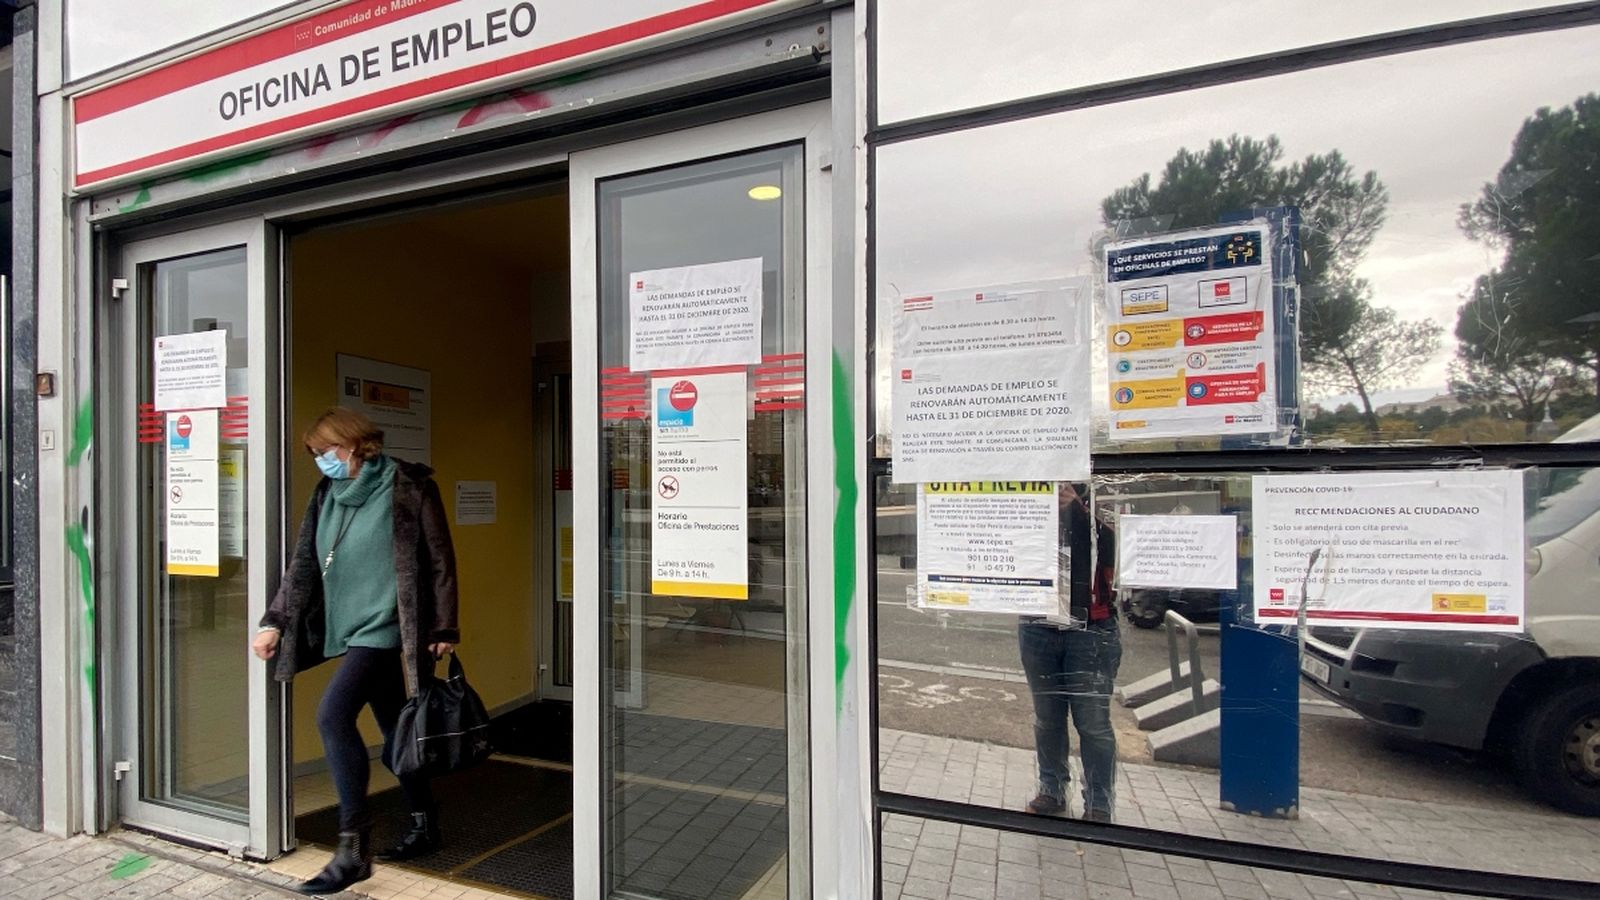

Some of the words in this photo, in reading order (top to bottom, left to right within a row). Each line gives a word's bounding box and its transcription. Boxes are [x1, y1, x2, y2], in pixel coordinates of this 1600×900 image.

[315, 10, 372, 36] Comunidad
[374, 5, 387, 17] de
[219, 62, 331, 121] OFICINA
[340, 47, 381, 87] DE
[390, 1, 537, 73] EMPLEO
[1113, 256, 1131, 265] ¿QUÉ
[1133, 251, 1171, 262] SERVICIOS
[1184, 245, 1218, 255] PRESTAN
[1125, 262, 1159, 272] OFICINAS
[1172, 256, 1206, 267] EMPLEO?
[660, 291, 695, 300] DEMANDAS
[706, 287, 732, 296] EMPLEO
[1130, 290, 1160, 303] SEPE
[687, 309, 720, 318] DICIEMBRE
[918, 387, 934, 395] LAS
[936, 384, 990, 395] DEMANDAS
[991, 383, 1001, 391] DE
[1006, 380, 1045, 390] EMPLEO
[1047, 379, 1058, 388] SE
[910, 396, 966, 408] RENOVARÁN
[969, 392, 1068, 406] AUTOMÁTICAMENTE
[906, 412, 935, 421] HASTA
[937, 412, 947, 420] EL
[949, 411, 959, 420] 31
[962, 410, 974, 419] DE
[976, 408, 1027, 419] DICIEMBRE
[1031, 407, 1043, 416] DE
[1046, 406, 1072, 415] 2020.
[1414, 507, 1480, 515] CIUDADANO
[694, 522, 739, 531] Prestaciones
[1284, 538, 1330, 546] obligatorio
[1377, 552, 1443, 560] correctamente
[1274, 566, 1302, 574] Espere
[1441, 568, 1482, 576] distancia
[1380, 578, 1418, 586] durante
[1428, 578, 1461, 587] tiempo
